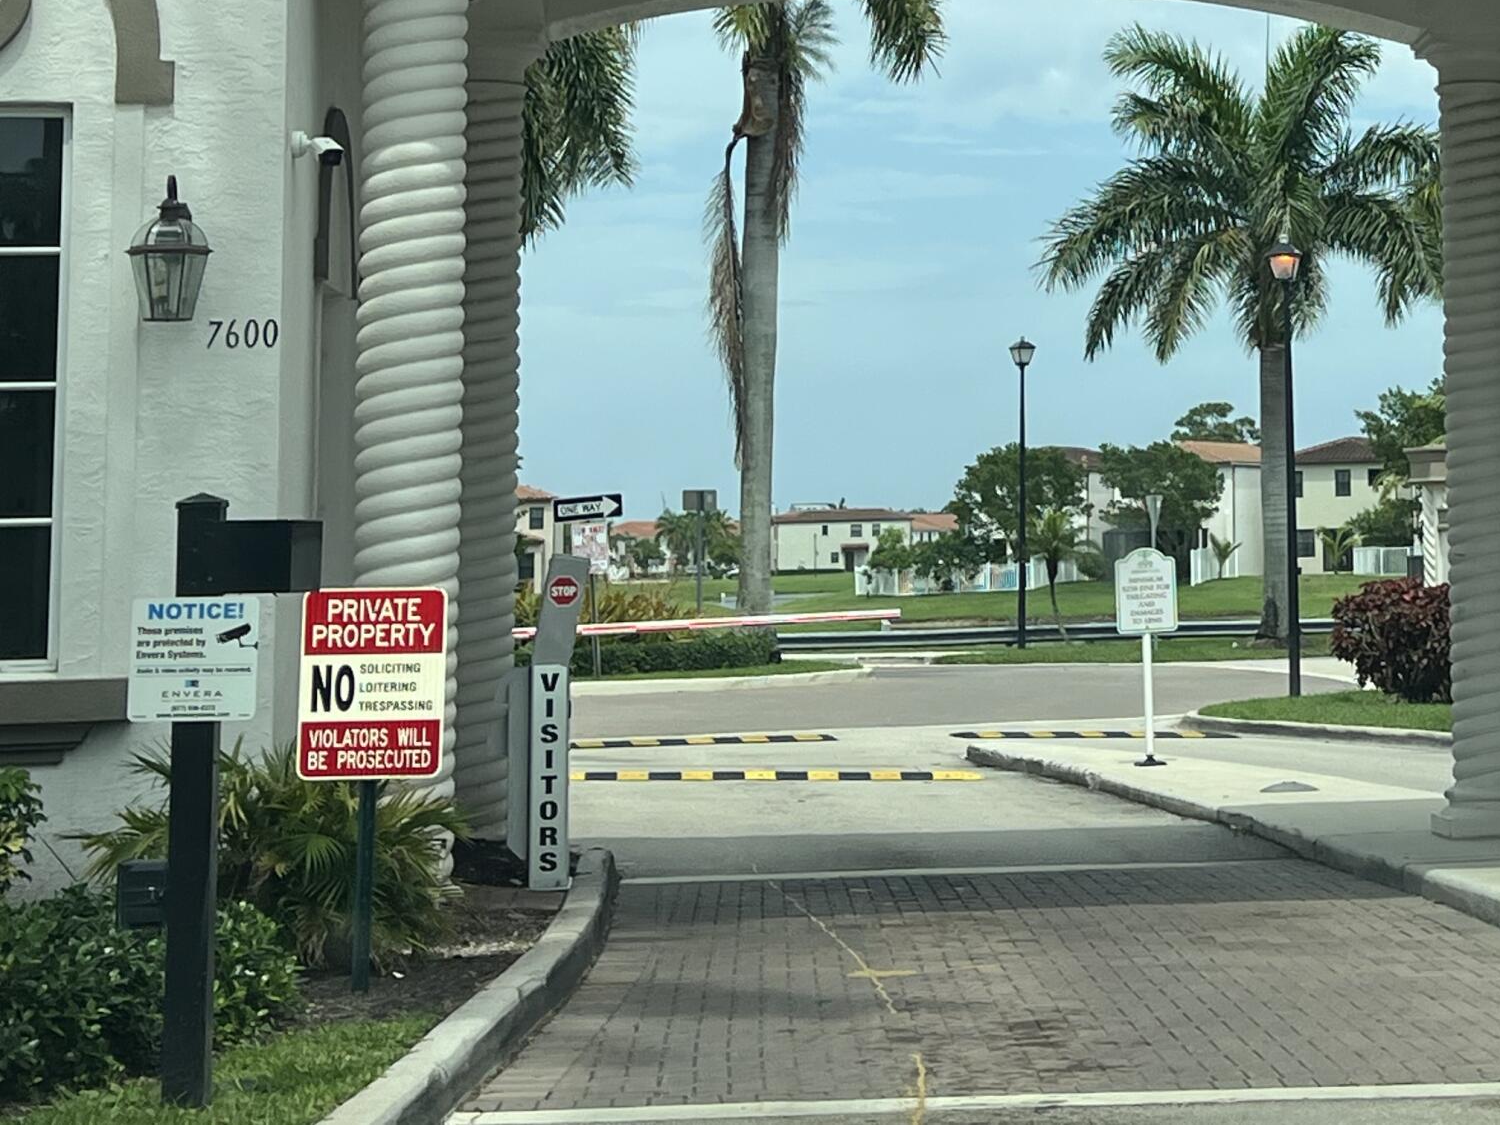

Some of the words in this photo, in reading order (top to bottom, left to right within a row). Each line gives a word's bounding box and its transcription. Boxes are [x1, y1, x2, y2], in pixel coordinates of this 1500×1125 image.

[206, 319, 279, 349] 7600
[560, 504, 579, 515] ONE
[582, 502, 602, 513] WAY
[551, 586, 577, 597] STOP
[147, 602, 245, 620] NOTICE!
[327, 598, 422, 623] PRIVATE
[153, 638, 194, 648] protected
[196, 638, 206, 648] by
[311, 623, 436, 648] PROPERTY
[136, 650, 165, 660] Envera
[359, 662, 421, 675] SOLICITING
[161, 690, 223, 698] ENVERA
[310, 664, 355, 713] NO
[359, 681, 417, 693] LOITERING
[358, 700, 433, 712] TRESPASSING
[309, 728, 389, 748] VIOLATORS
[397, 727, 432, 747] WILL
[307, 750, 329, 771] BE
[336, 749, 432, 771] PROSECUTED
[539, 673, 560, 873] VISITORS
